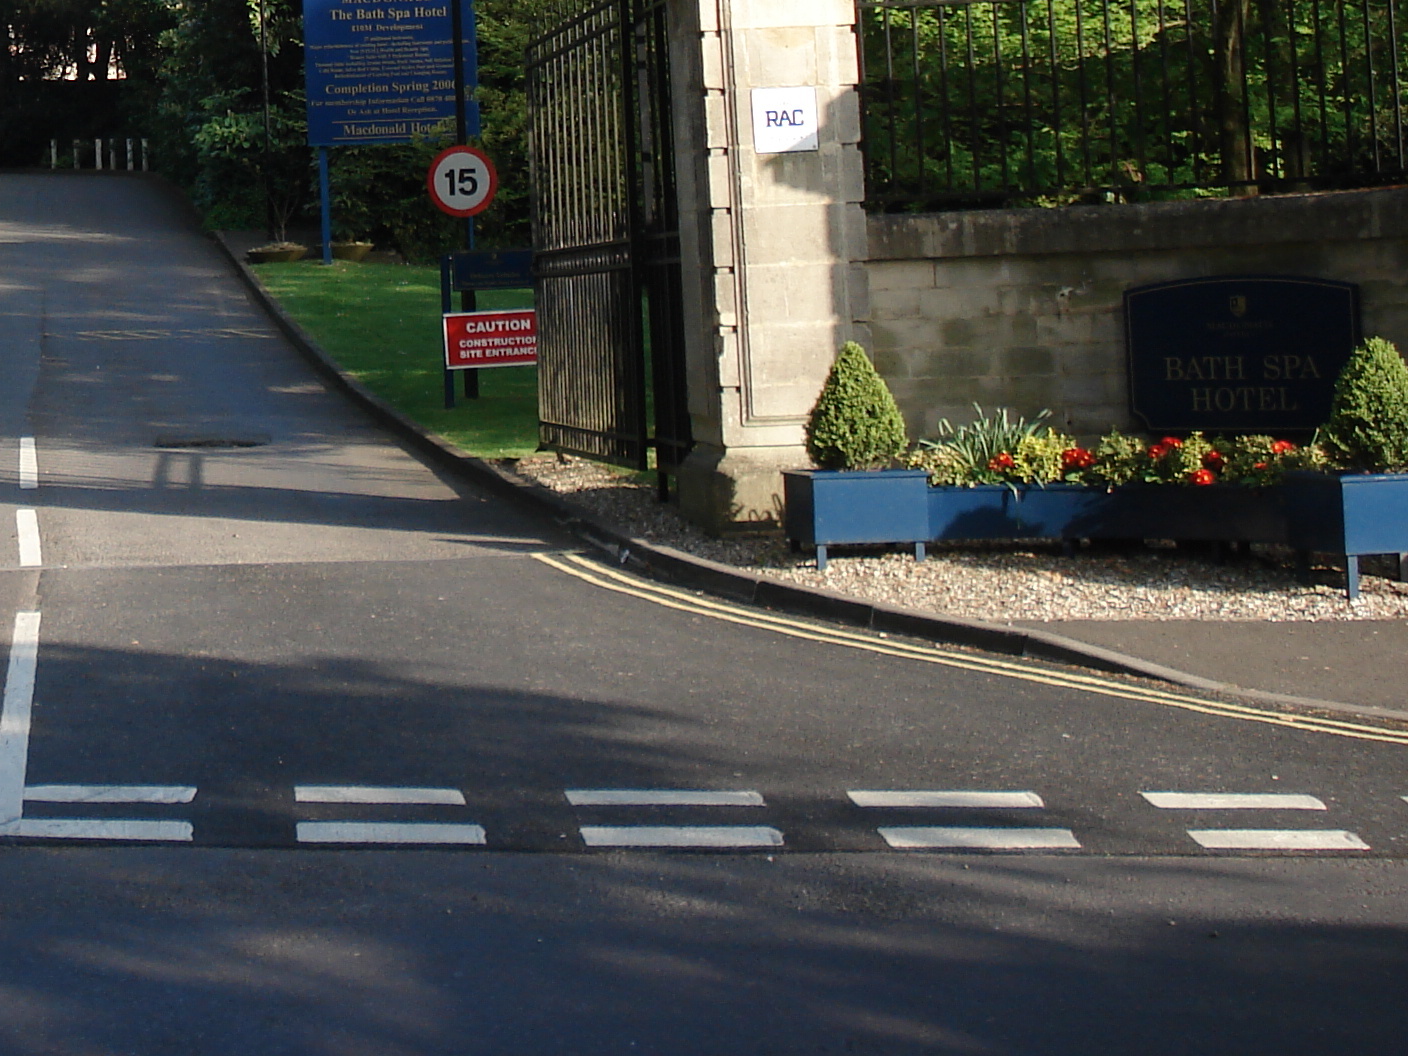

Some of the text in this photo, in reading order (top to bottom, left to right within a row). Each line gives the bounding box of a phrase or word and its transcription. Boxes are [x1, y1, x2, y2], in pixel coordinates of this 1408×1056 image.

[330, 5, 447, 21] The Bath Spa Hotel
[376, 23, 424, 32] Development
[325, 82, 389, 96] Completion
[391, 80, 430, 94] Spring
[766, 109, 804, 127] RAC
[343, 122, 406, 136] Macdonald
[444, 168, 478, 197] 15
[466, 318, 531, 334] CAUTION
[460, 349, 483, 359] SITE
[1164, 355, 1321, 381] BATH SPA
[1192, 388, 1297, 411] HOTEL
